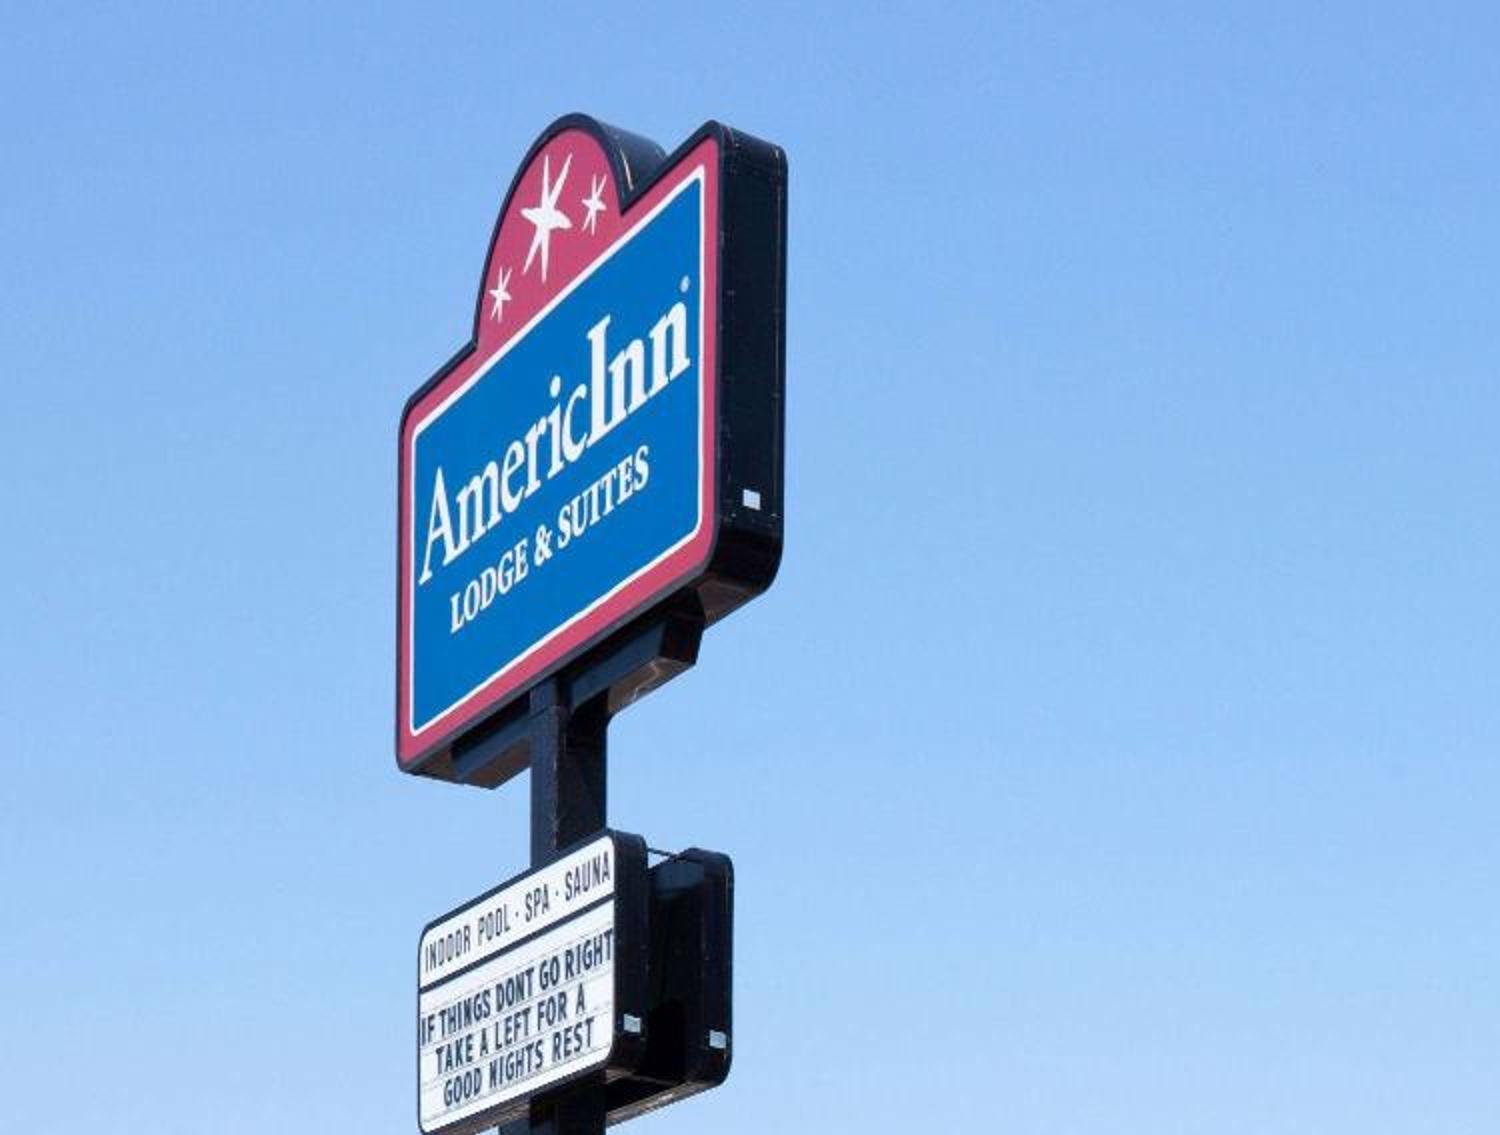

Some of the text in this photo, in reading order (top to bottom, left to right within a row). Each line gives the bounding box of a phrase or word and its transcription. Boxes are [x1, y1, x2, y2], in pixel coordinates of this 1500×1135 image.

[419, 299, 691, 586] AmericInn
[450, 444, 651, 634] LODGE & SUITES
[425, 851, 611, 973] INDOOR POOL SPA SAUNA
[421, 927, 613, 1046] IF THINGS DONT GO RIGHT
[435, 983, 585, 1075] TAKE A LEFT FOR A
[443, 1017, 594, 1107] GOOD NIGHTS REST
